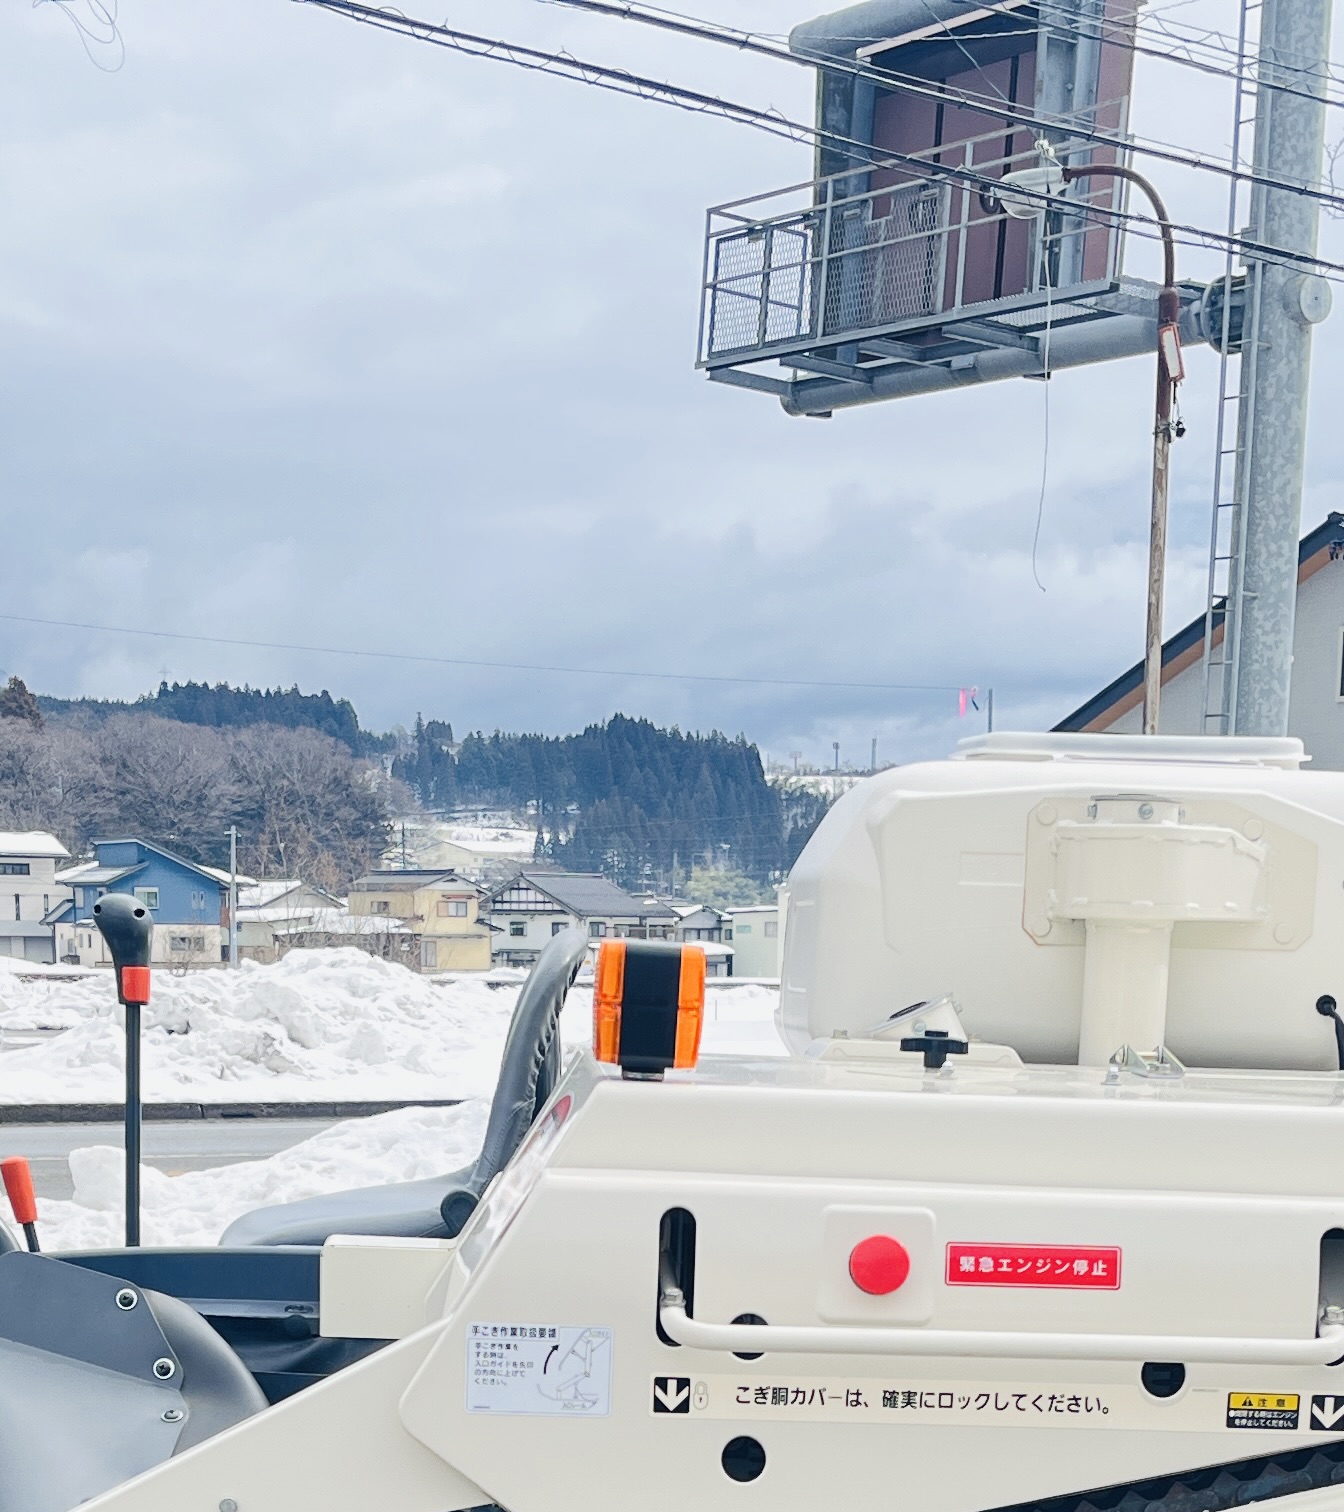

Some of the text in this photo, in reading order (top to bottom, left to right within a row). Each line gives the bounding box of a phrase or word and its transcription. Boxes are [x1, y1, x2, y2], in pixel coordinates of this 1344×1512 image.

[959, 1256, 1107, 1276] 緊急エンジン停止
[736, 1386, 1110, 1415] こぎ胴カバーは、確実にロックしてください。
